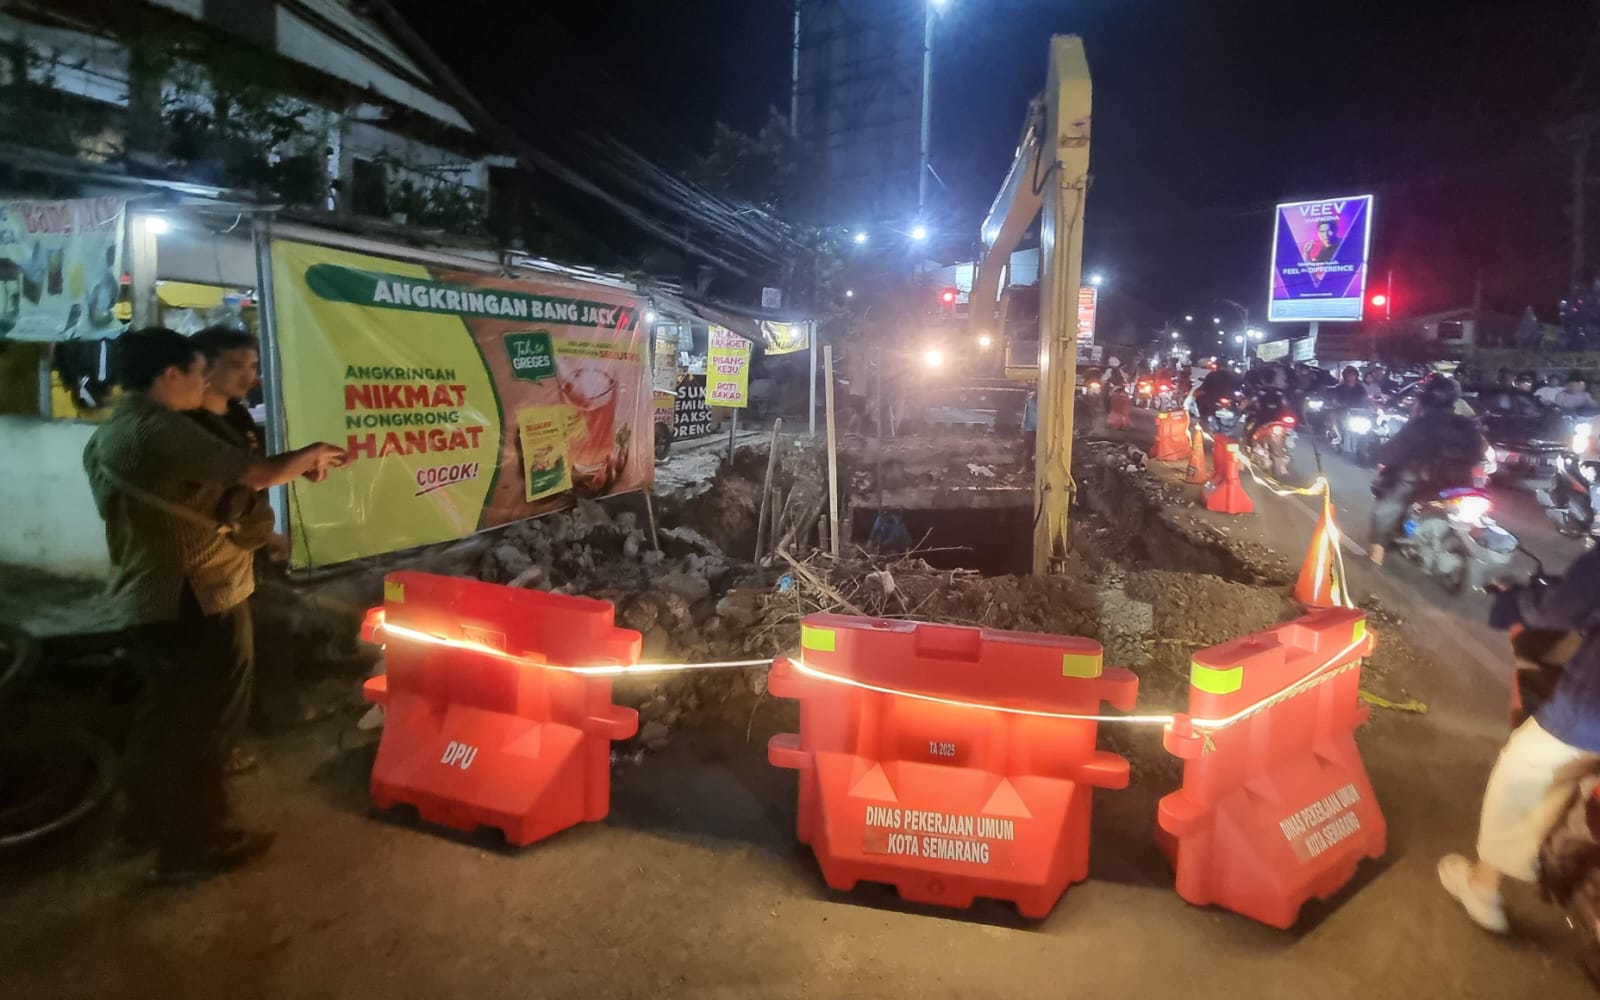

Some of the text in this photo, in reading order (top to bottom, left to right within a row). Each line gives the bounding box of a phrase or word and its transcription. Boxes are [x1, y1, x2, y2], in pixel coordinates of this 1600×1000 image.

[1299, 201, 1347, 217] VEEV
[1282, 267, 1300, 275] FEEL
[1308, 264, 1354, 274] DIFFERENCE
[373, 280, 616, 325] ANGKRINGAN BANG JACK
[513, 355, 550, 370] GREGES
[712, 356, 745, 366] PISANG
[717, 365, 739, 374] KEJU
[345, 365, 456, 381] ANGKRINGAN
[711, 390, 742, 400] BAKAR
[717, 382, 737, 391] ROTI
[344, 384, 467, 410] NIKMAT
[346, 411, 459, 429] NONGKRONG
[346, 426, 484, 460] HANGAT
[417, 463, 479, 486] COCOK!
[440, 741, 478, 770] DPU
[929, 741, 956, 756] TA 2025
[866, 806, 1014, 840] DINAS PEKERJAAN UMUM
[888, 833, 990, 864] KOTA SEMARANG
[1305, 831, 1330, 857] KOTA
